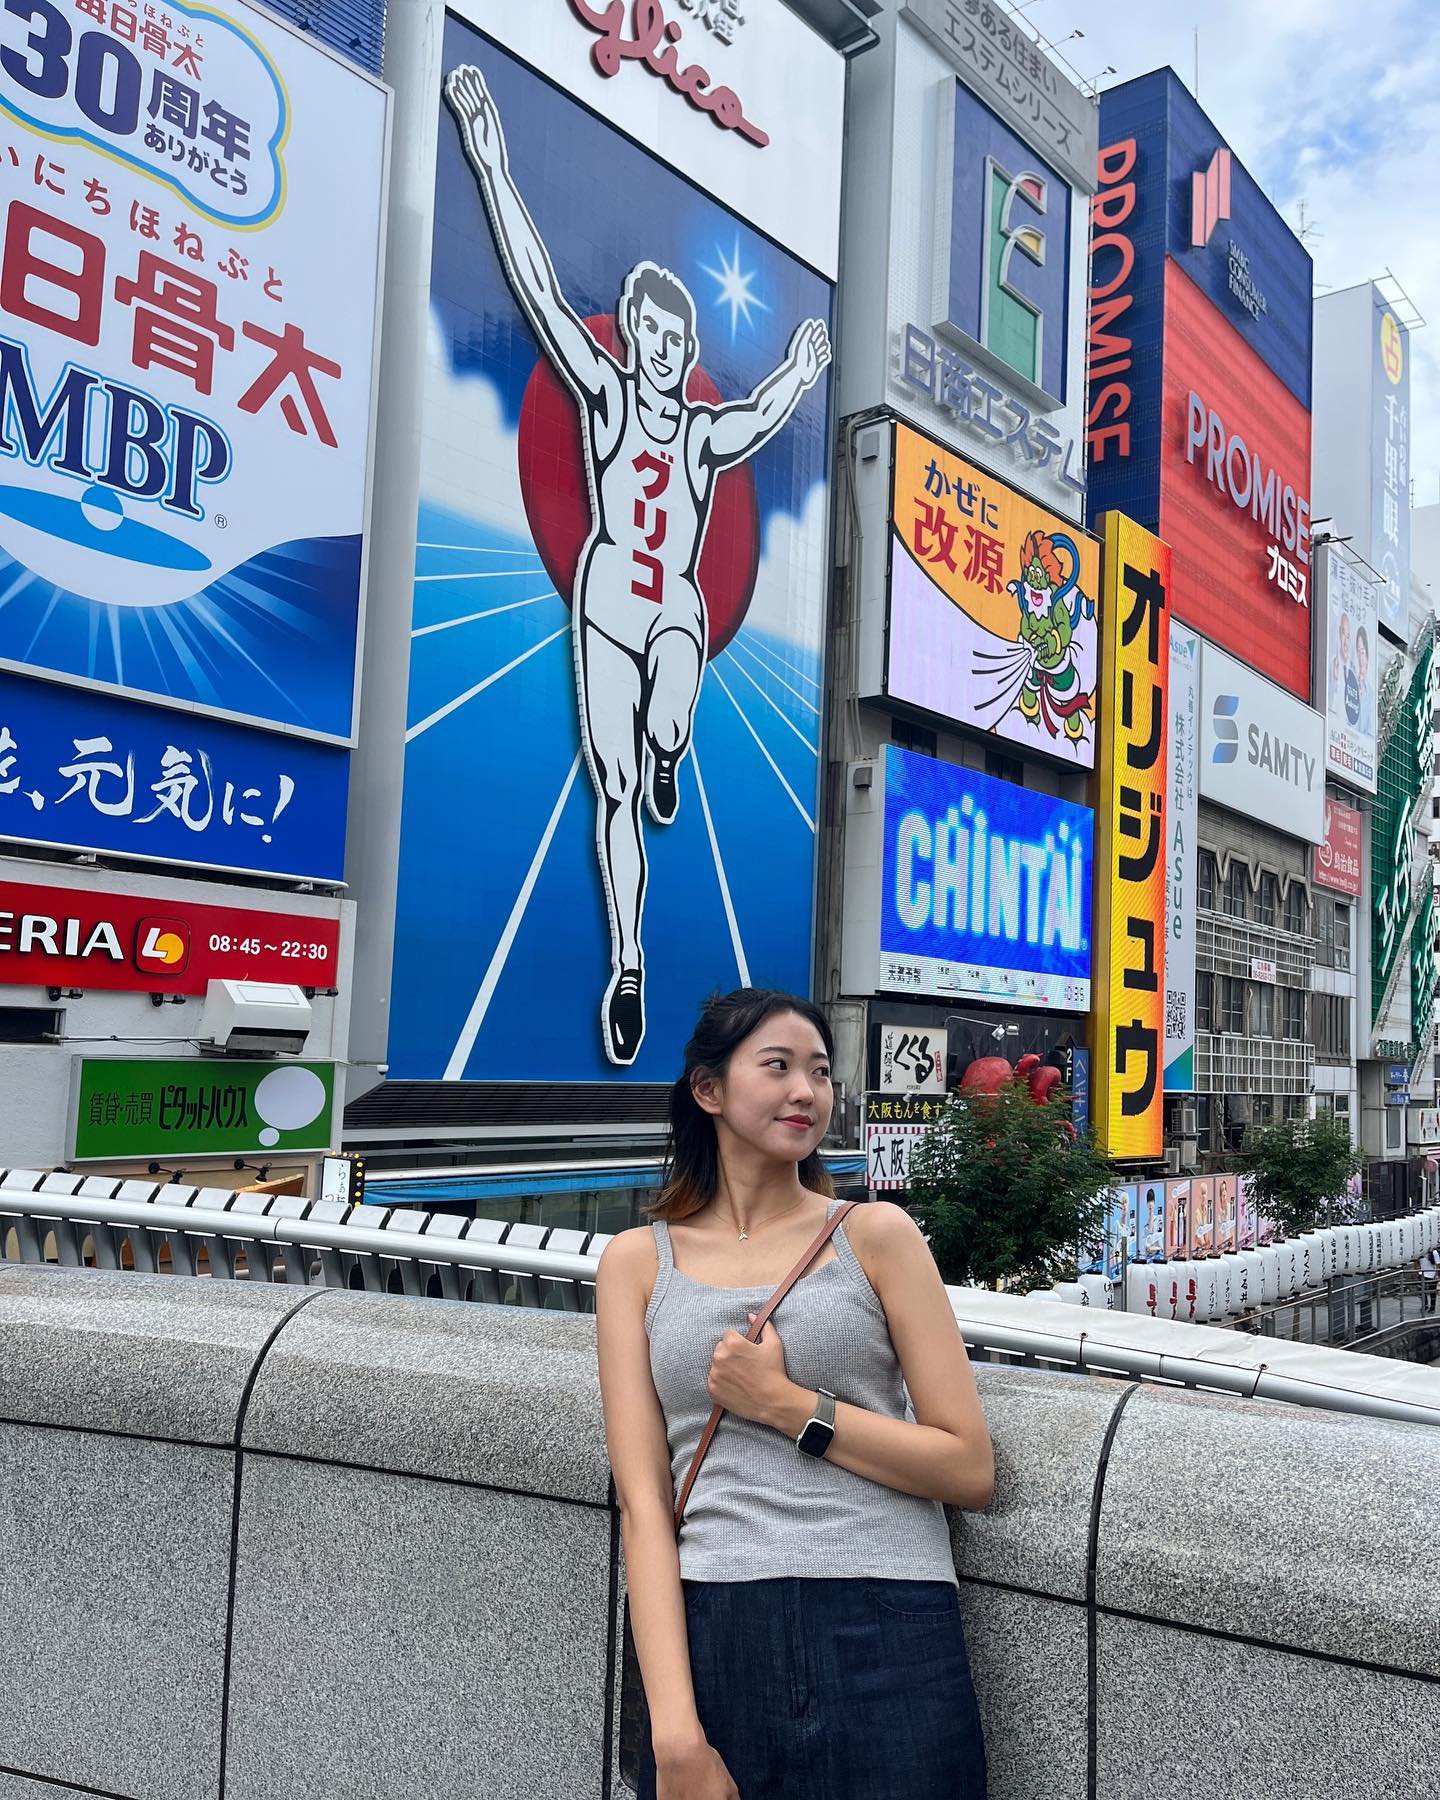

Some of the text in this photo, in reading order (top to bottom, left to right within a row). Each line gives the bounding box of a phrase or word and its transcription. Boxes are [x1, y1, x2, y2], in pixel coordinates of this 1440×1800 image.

[944, 9, 1071, 156] エステムシリーズ
[144, 123, 249, 196] ありがとう
[1, 200, 342, 449] 日骨太
[1086, 137, 1136, 462] PROMISE
[0, 340, 230, 518] MBP
[1186, 390, 1311, 566] PROMISE
[631, 449, 674, 605] グリコ
[924, 459, 999, 530] かぜに
[913, 497, 1005, 595] 改源
[1267, 545, 1309, 608] プロミス
[1246, 722, 1316, 793] SAMTY
[1115, 562, 1166, 1118] オリジュウ
[159, 1084, 249, 1131] ピタットハウス
[893, 1033, 935, 1085] くくる
[89, 1090, 154, 1127] 賃貸・売買
